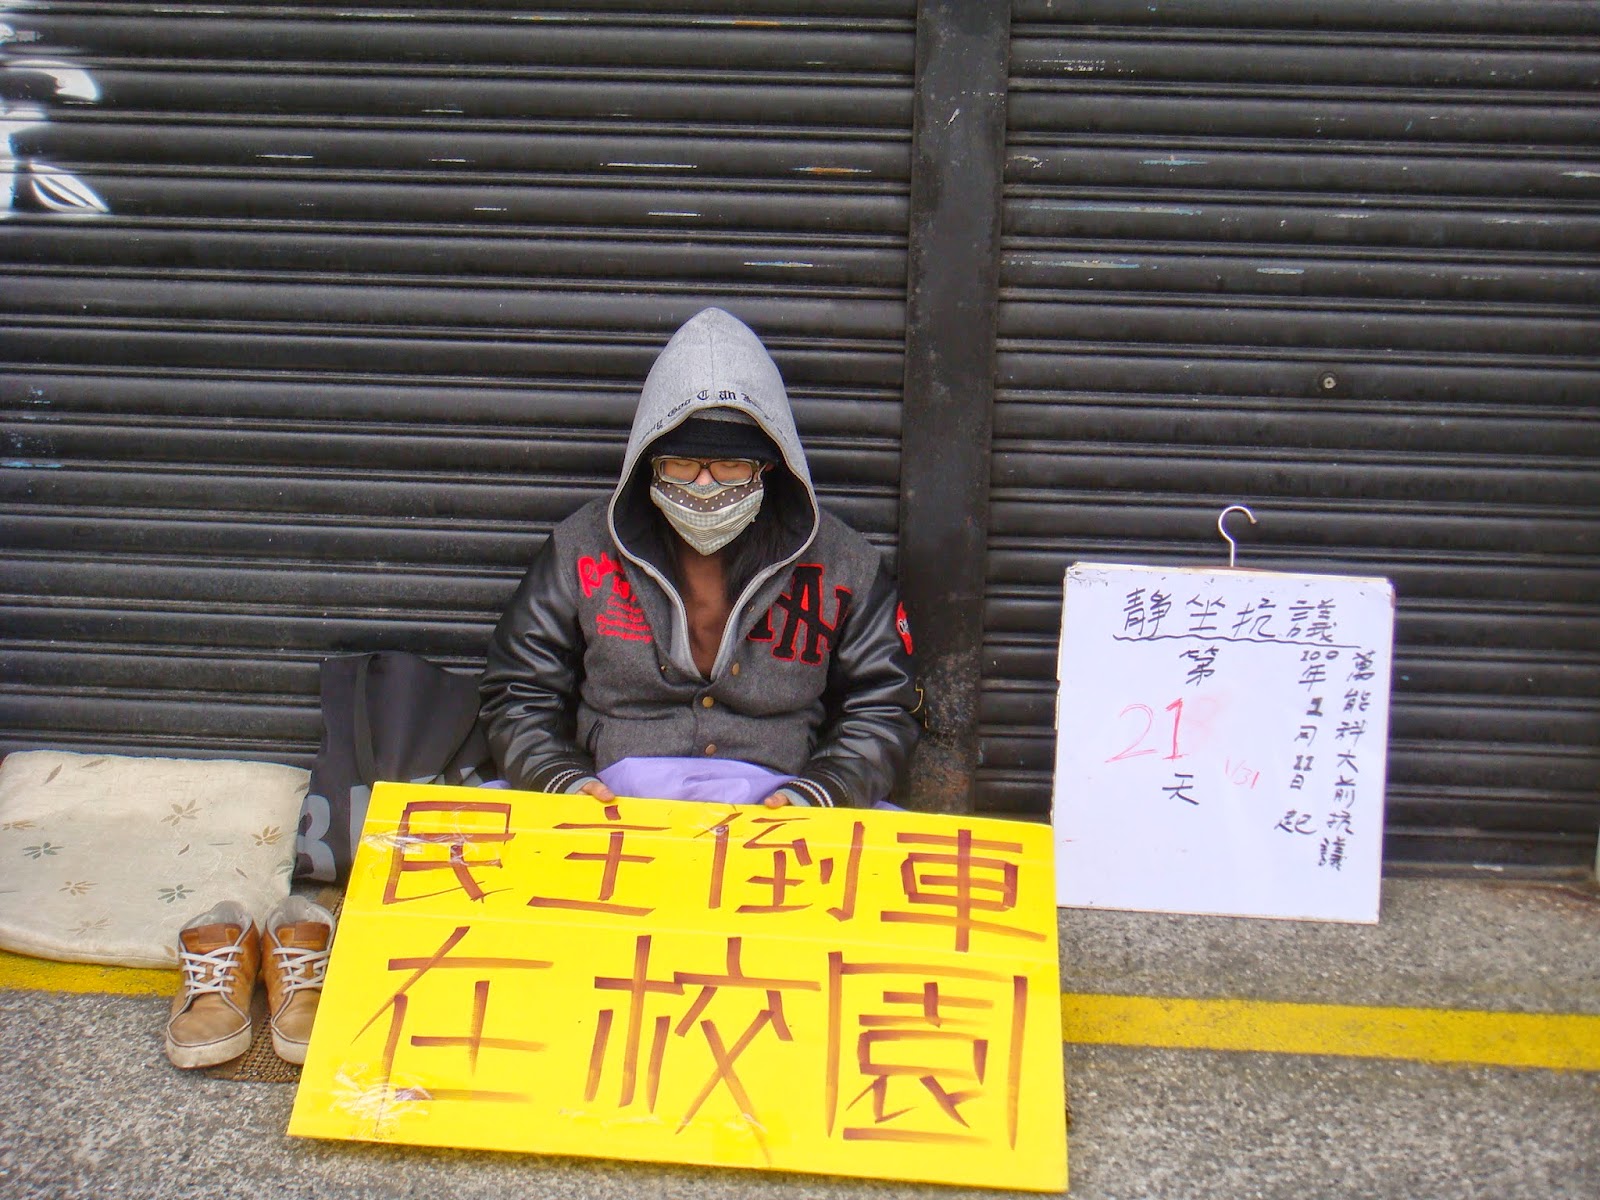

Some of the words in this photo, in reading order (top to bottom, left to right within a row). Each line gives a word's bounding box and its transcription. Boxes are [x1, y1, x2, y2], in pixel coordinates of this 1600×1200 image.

[1123, 588, 1338, 643] 靜坐抗議
[1161, 772, 1200, 806] 天
[382, 801, 1047, 953] 民主倒車
[352, 925, 1029, 1163] 在校園
